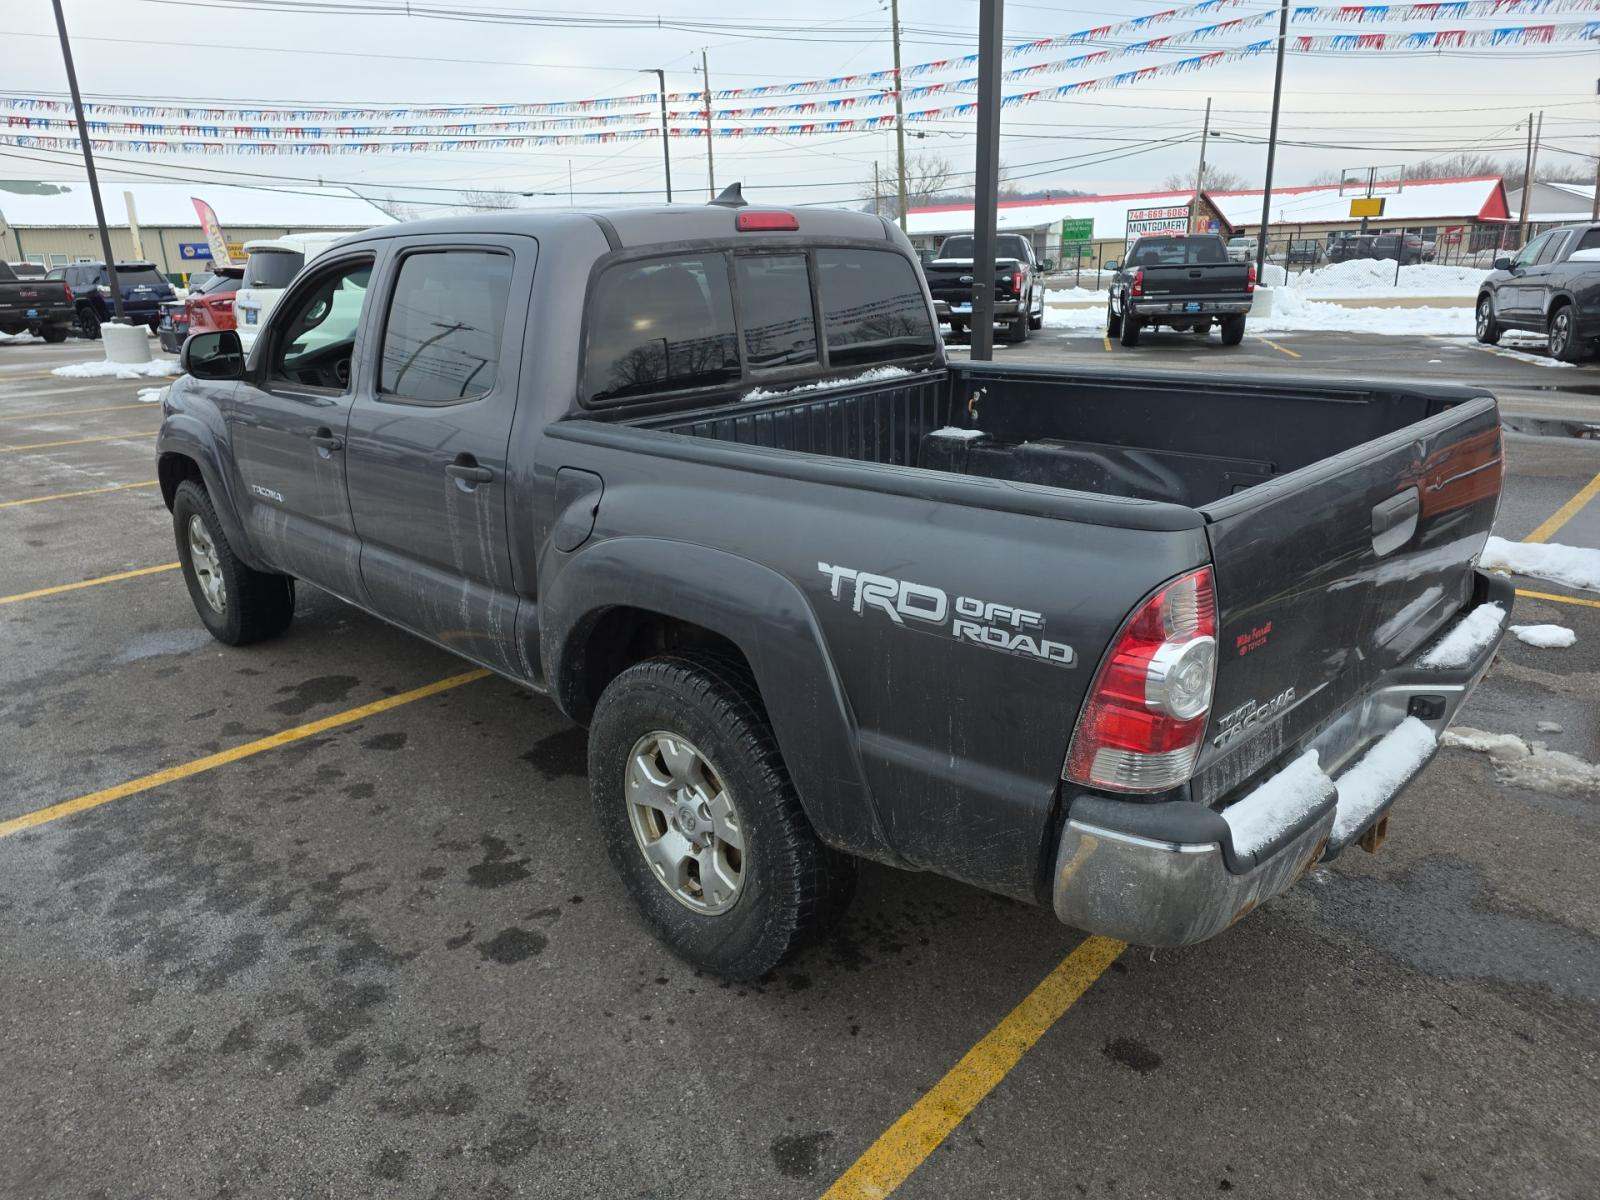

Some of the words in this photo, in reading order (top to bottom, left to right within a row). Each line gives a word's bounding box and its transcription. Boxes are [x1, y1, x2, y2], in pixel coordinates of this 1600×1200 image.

[1128, 220, 1187, 233] MONTGOMERY
[817, 561, 948, 625] TRD
[955, 595, 1045, 627] OFF
[952, 619, 1077, 666] ROAD
[1213, 687, 1297, 748] TACOMA
